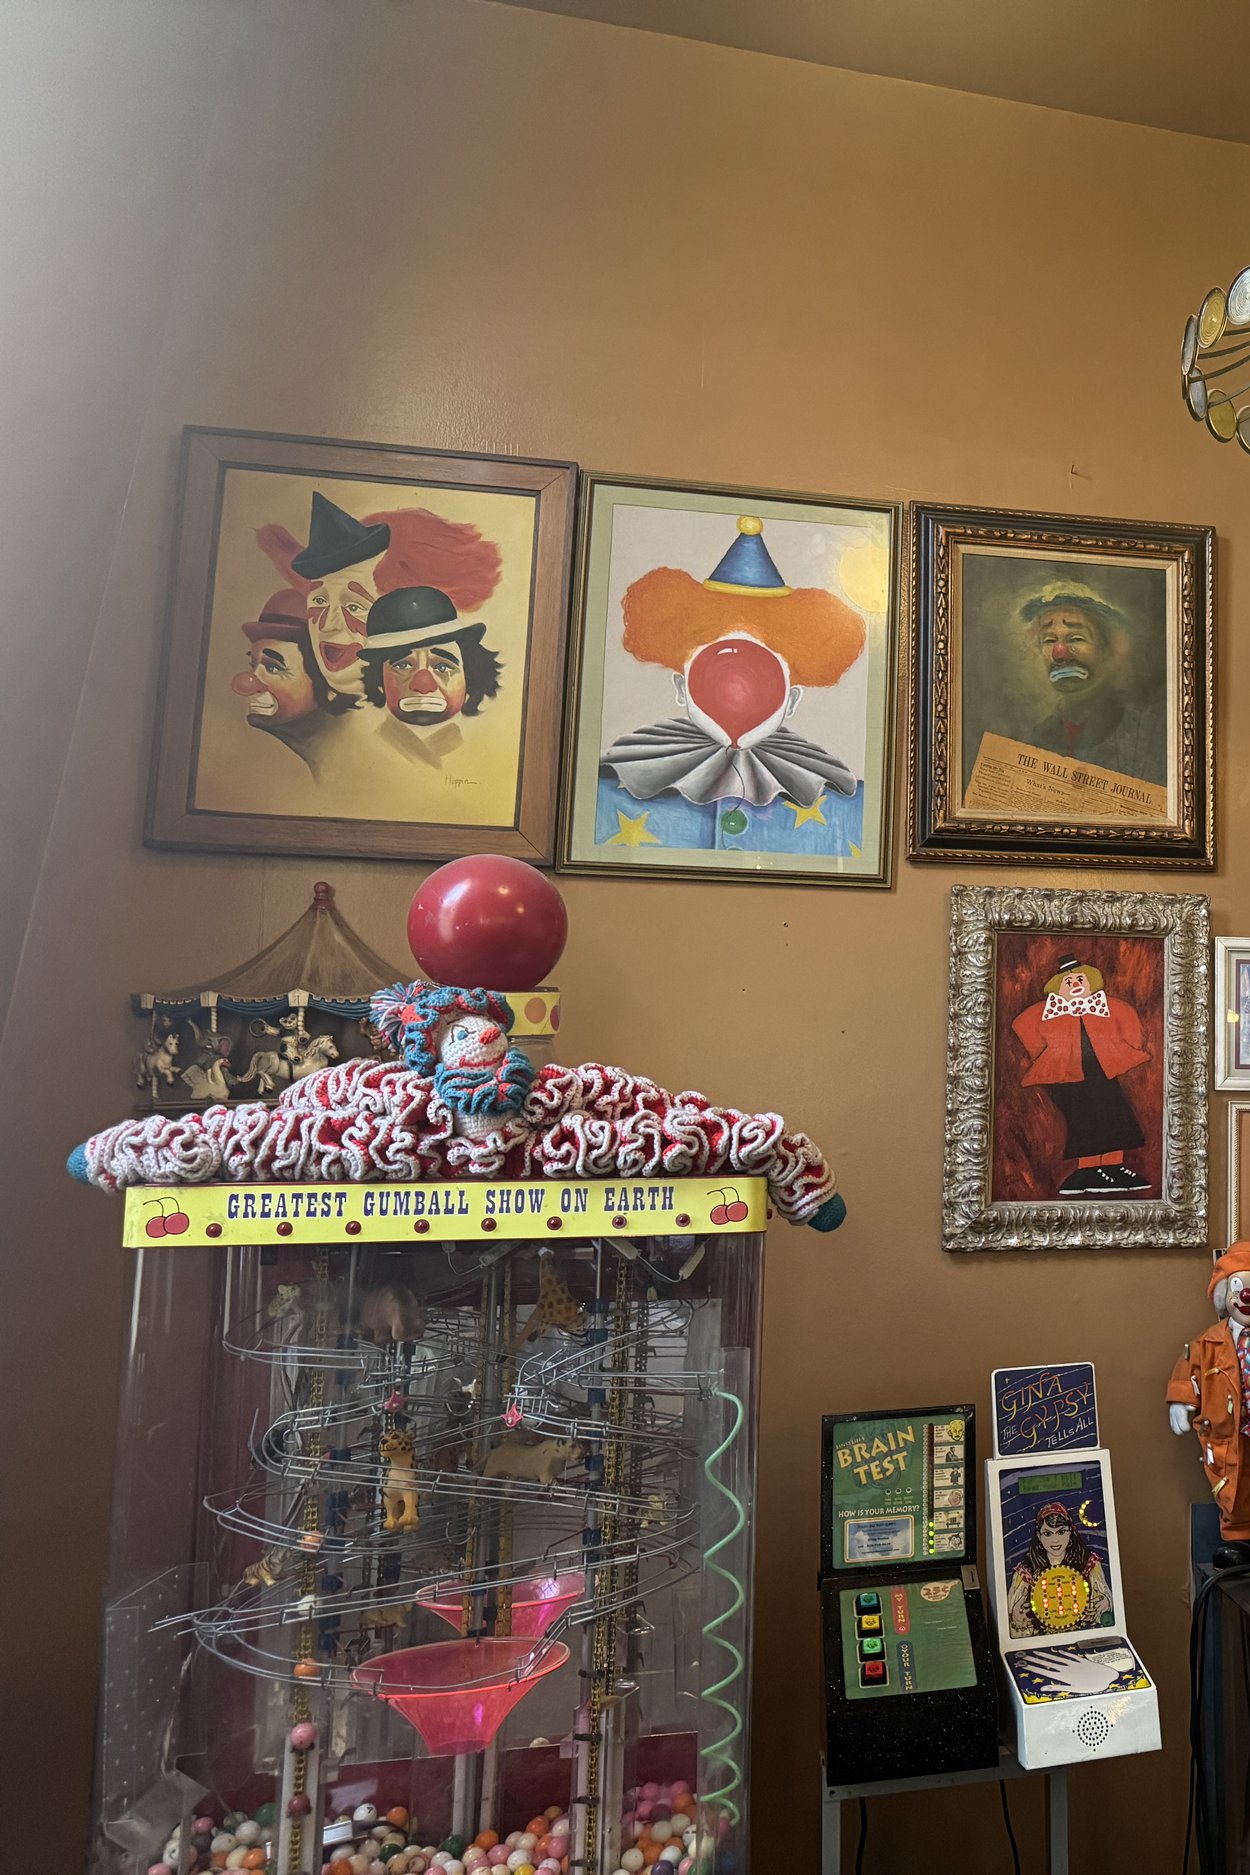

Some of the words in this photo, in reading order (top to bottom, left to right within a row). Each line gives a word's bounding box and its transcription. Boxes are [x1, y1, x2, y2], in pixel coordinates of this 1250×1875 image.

[1017, 753, 1039, 770] THE
[1042, 761, 1068, 779] WALL
[1071, 770, 1109, 790] STREET
[1110, 783, 1152, 805] JOURNAL
[228, 1192, 347, 1219] GREATEST
[363, 1190, 469, 1217] GUMBALL
[485, 1188, 545, 1214] SHOW
[560, 1187, 589, 1213] ON
[604, 1186, 674, 1211] EARTH
[1001, 1372, 1063, 1421] GINA
[1001, 1425, 1018, 1440] THE
[1020, 1382, 1089, 1448] GYPSY
[837, 1425, 915, 1468] BRAIN
[1045, 1429, 1075, 1448] TELLS
[1075, 1416, 1094, 1432] ALL
[854, 1451, 908, 1485] TEST
[838, 1510, 856, 1518] HOW
[857, 1509, 864, 1517] IS
[865, 1508, 885, 1516] YOUR
[885, 1505, 920, 1514] MEMORY?
[922, 1587, 950, 1596] 25¢
[904, 1671, 913, 1691] TURN
